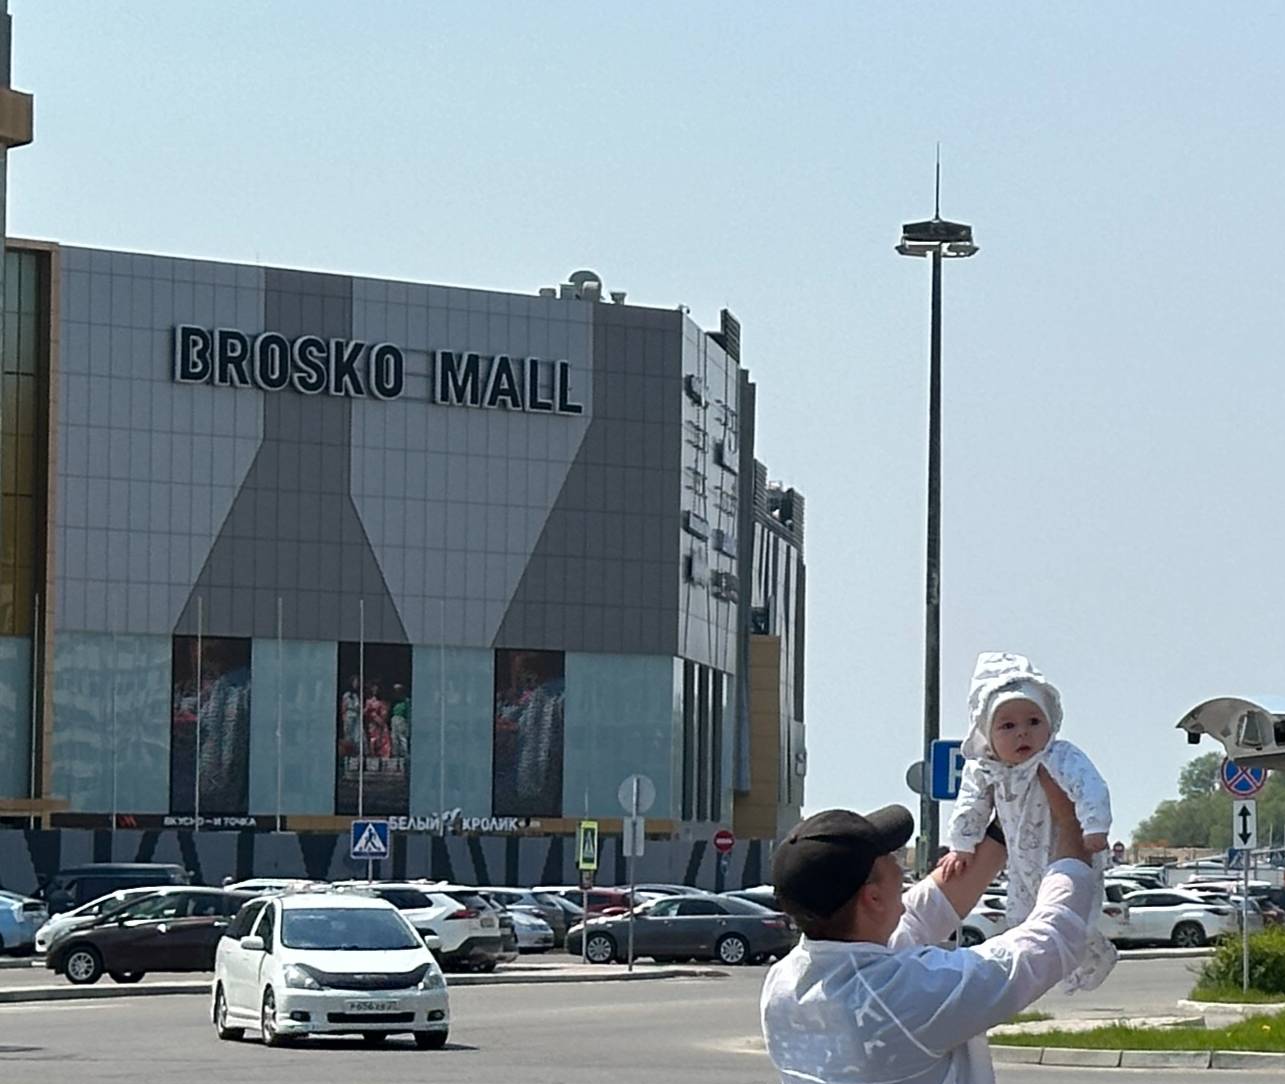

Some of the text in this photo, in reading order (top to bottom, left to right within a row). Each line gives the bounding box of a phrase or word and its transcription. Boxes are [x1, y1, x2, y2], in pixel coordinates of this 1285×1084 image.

[174, 323, 584, 416] BROSKO MALL
[389, 812, 440, 831] БЕЛЫЙ
[462, 817, 518, 832] КРОЛИК
